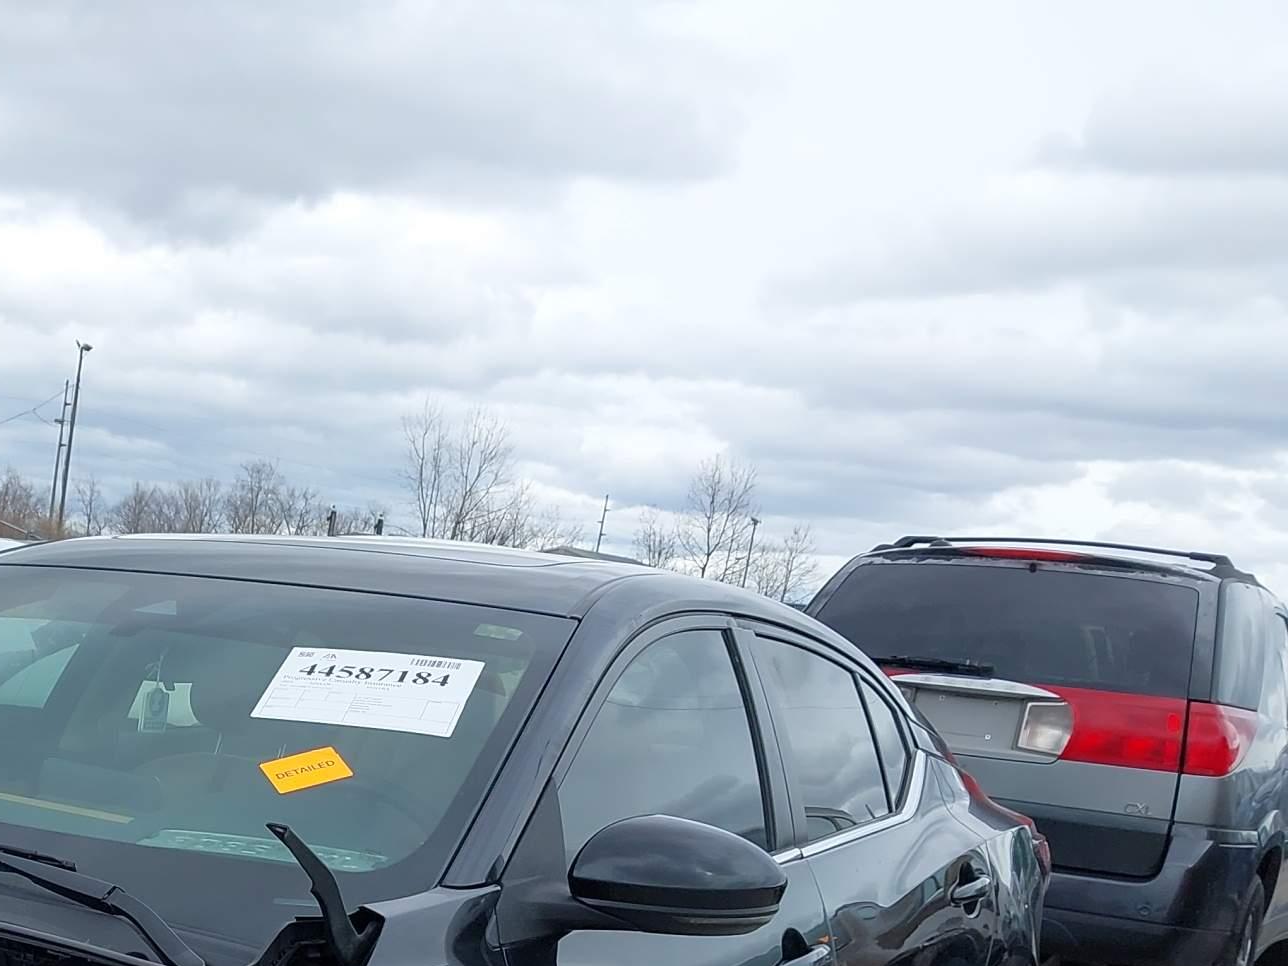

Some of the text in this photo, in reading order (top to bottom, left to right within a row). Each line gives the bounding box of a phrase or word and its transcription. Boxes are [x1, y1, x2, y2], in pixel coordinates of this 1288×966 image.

[299, 663, 451, 688] 44587184
[275, 760, 335, 780] DETAILED
[1124, 801, 1152, 815] CXL
